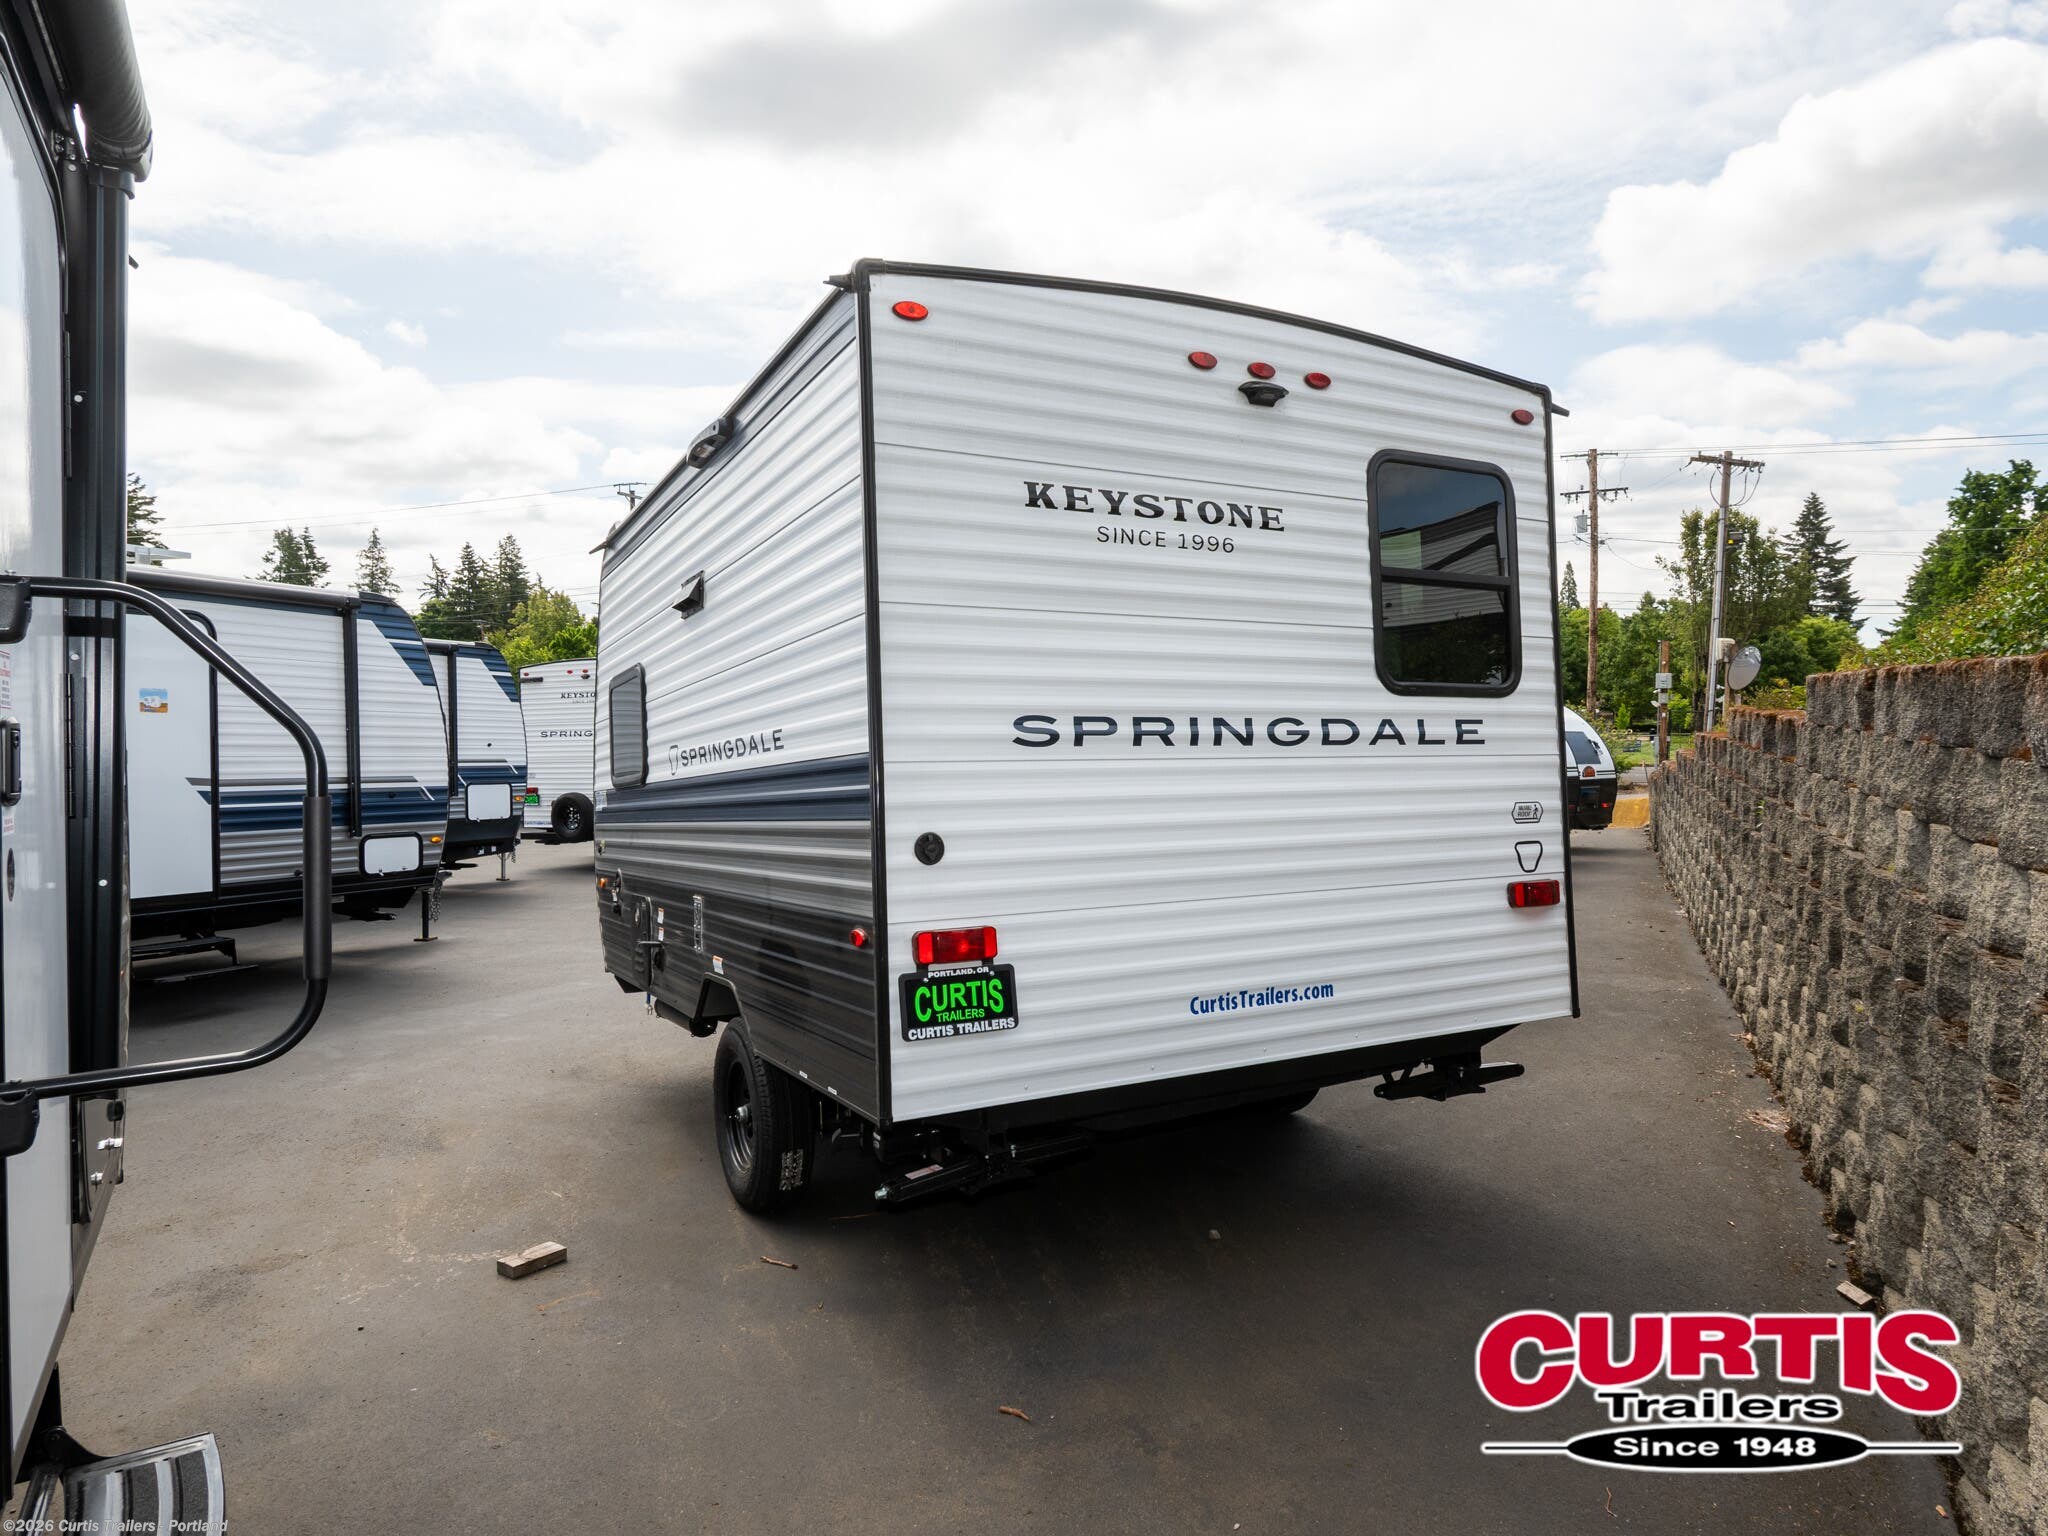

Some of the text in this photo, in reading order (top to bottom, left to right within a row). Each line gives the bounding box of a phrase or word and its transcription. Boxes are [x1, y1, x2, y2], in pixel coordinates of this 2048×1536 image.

[1023, 481, 1285, 532] KEYSTONE
[1096, 526, 1235, 553] SINCE 1996
[540, 730, 593, 738] SPRING
[1012, 714, 1486, 748] SPRINGDALE
[680, 728, 785, 767] SPRINGDALE
[977, 966, 990, 974] OR
[914, 978, 1004, 1023] CURTIS
[1190, 983, 1334, 1015] CurtisTrailers.com
[908, 1017, 1016, 1041] CURTIS TRAILERS
[936, 1008, 985, 1023] TRAILERS
